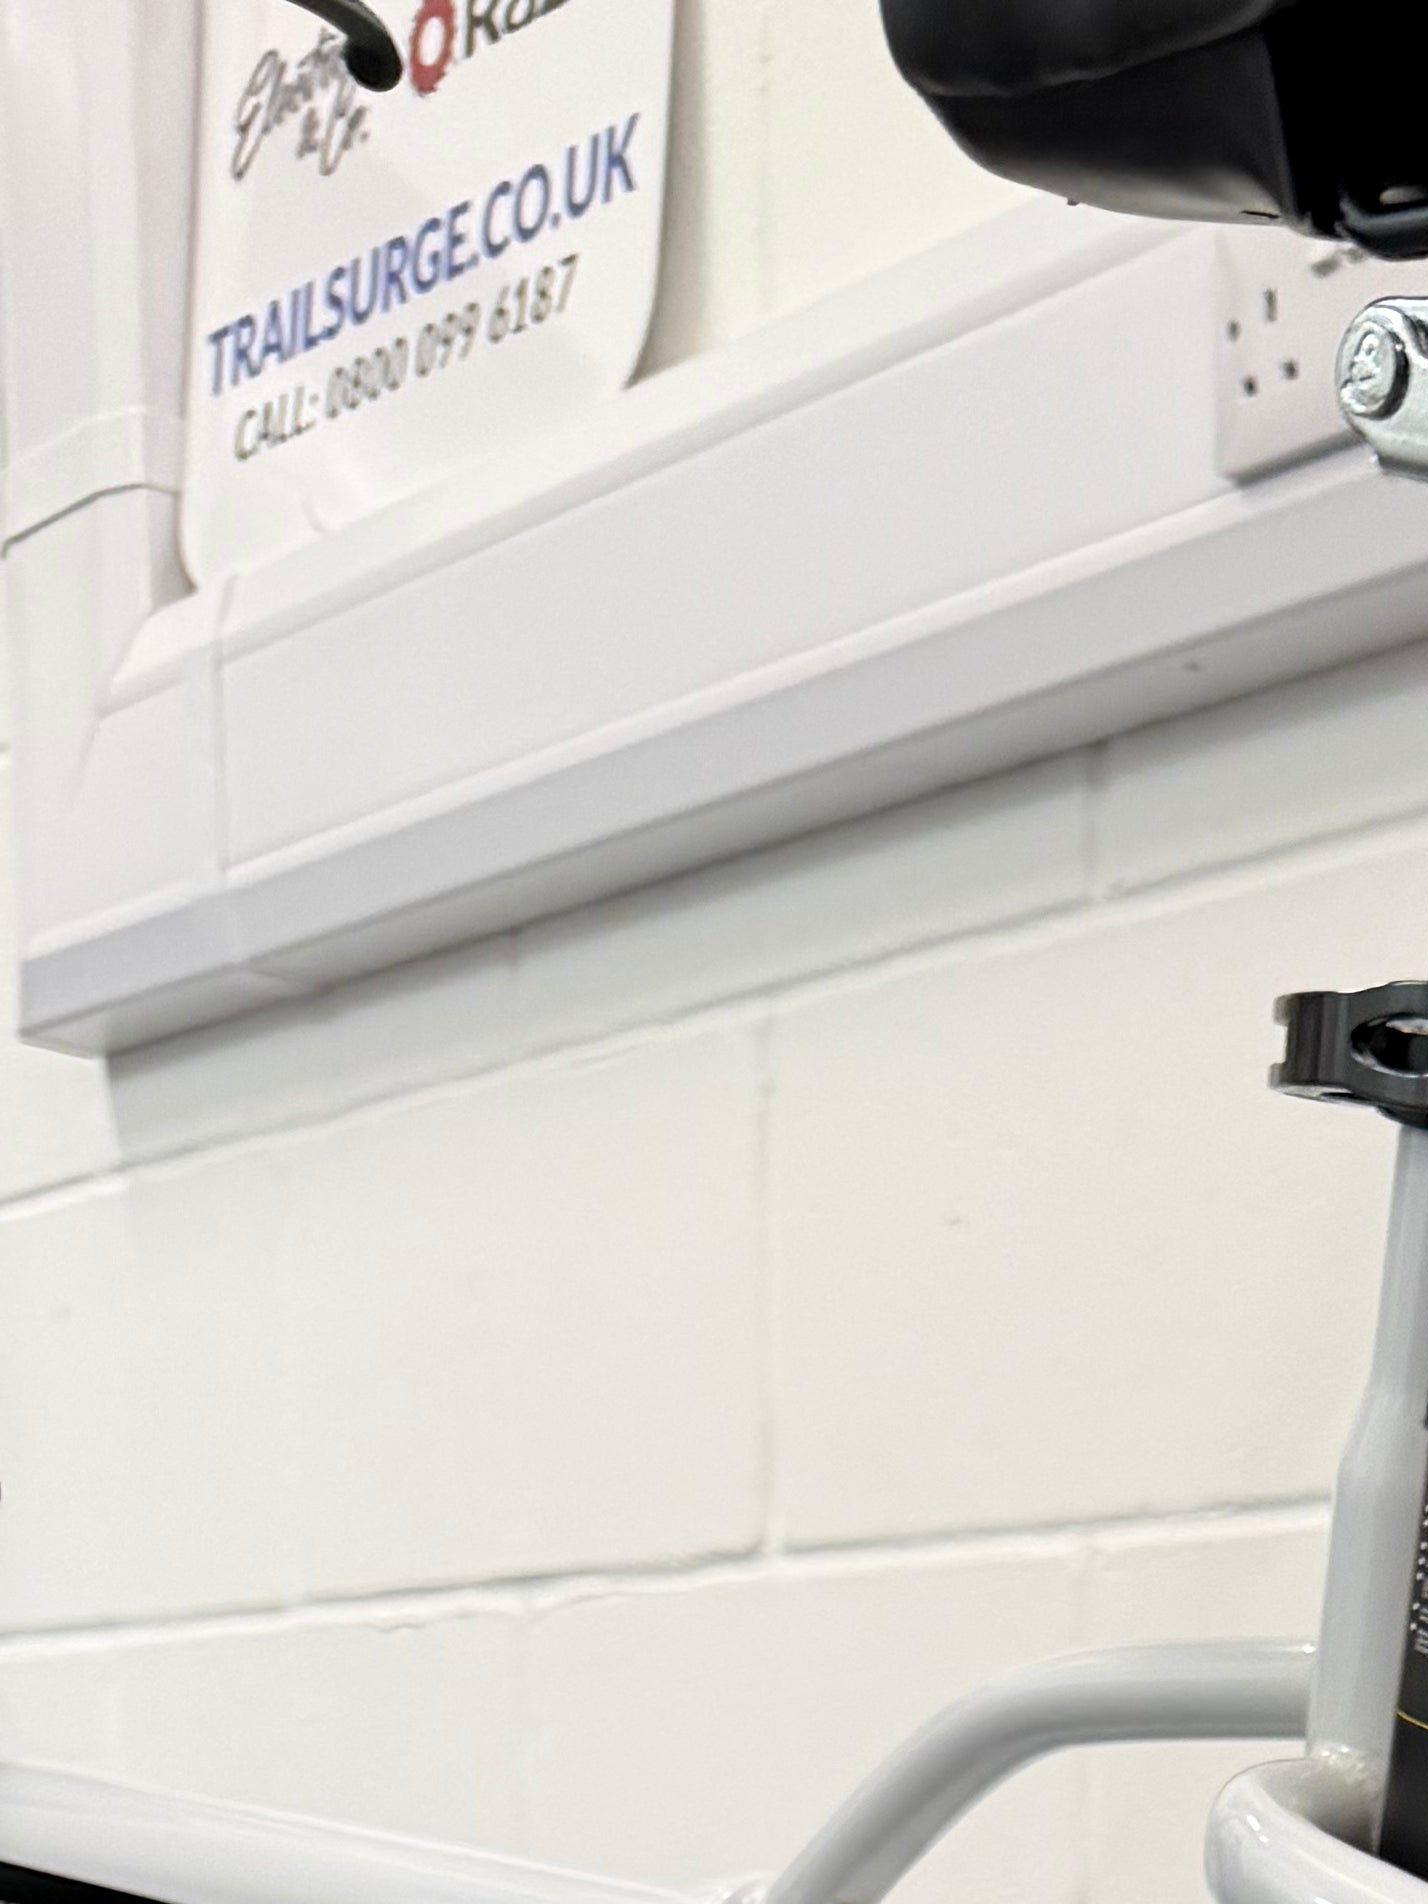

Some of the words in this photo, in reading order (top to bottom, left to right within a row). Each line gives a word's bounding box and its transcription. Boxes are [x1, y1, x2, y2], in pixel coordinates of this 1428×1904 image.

[207, 112, 640, 396] TRAILSURGE.CO.UK
[325, 336, 409, 419] 0800
[415, 302, 481, 378] 099
[488, 253, 580, 343] 6187
